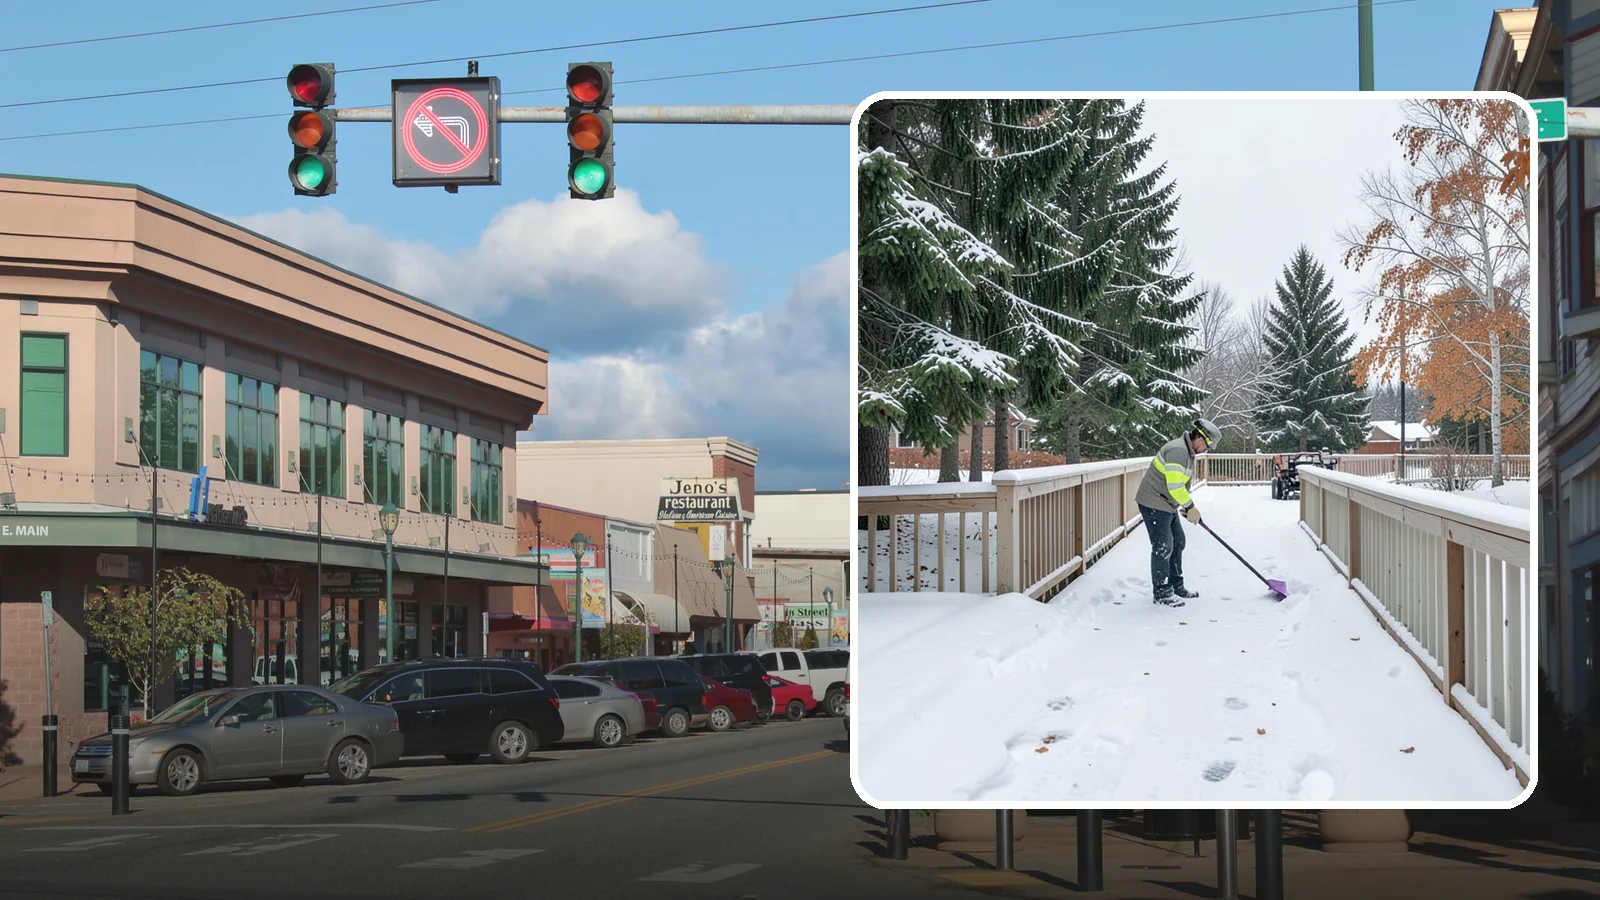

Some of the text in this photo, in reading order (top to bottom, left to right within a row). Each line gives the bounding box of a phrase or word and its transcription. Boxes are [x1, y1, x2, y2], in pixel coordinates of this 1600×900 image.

[670, 480, 727, 494] Jeno's
[665, 496, 731, 508] restaurant
[659, 510, 681, 520] Italian
[686, 509, 714, 519] American
[715, 510, 737, 519] Cuisine
[2, 525, 49, 536] E. MAIN
[797, 607, 828, 617] Street
[790, 619, 824, 627] lass
